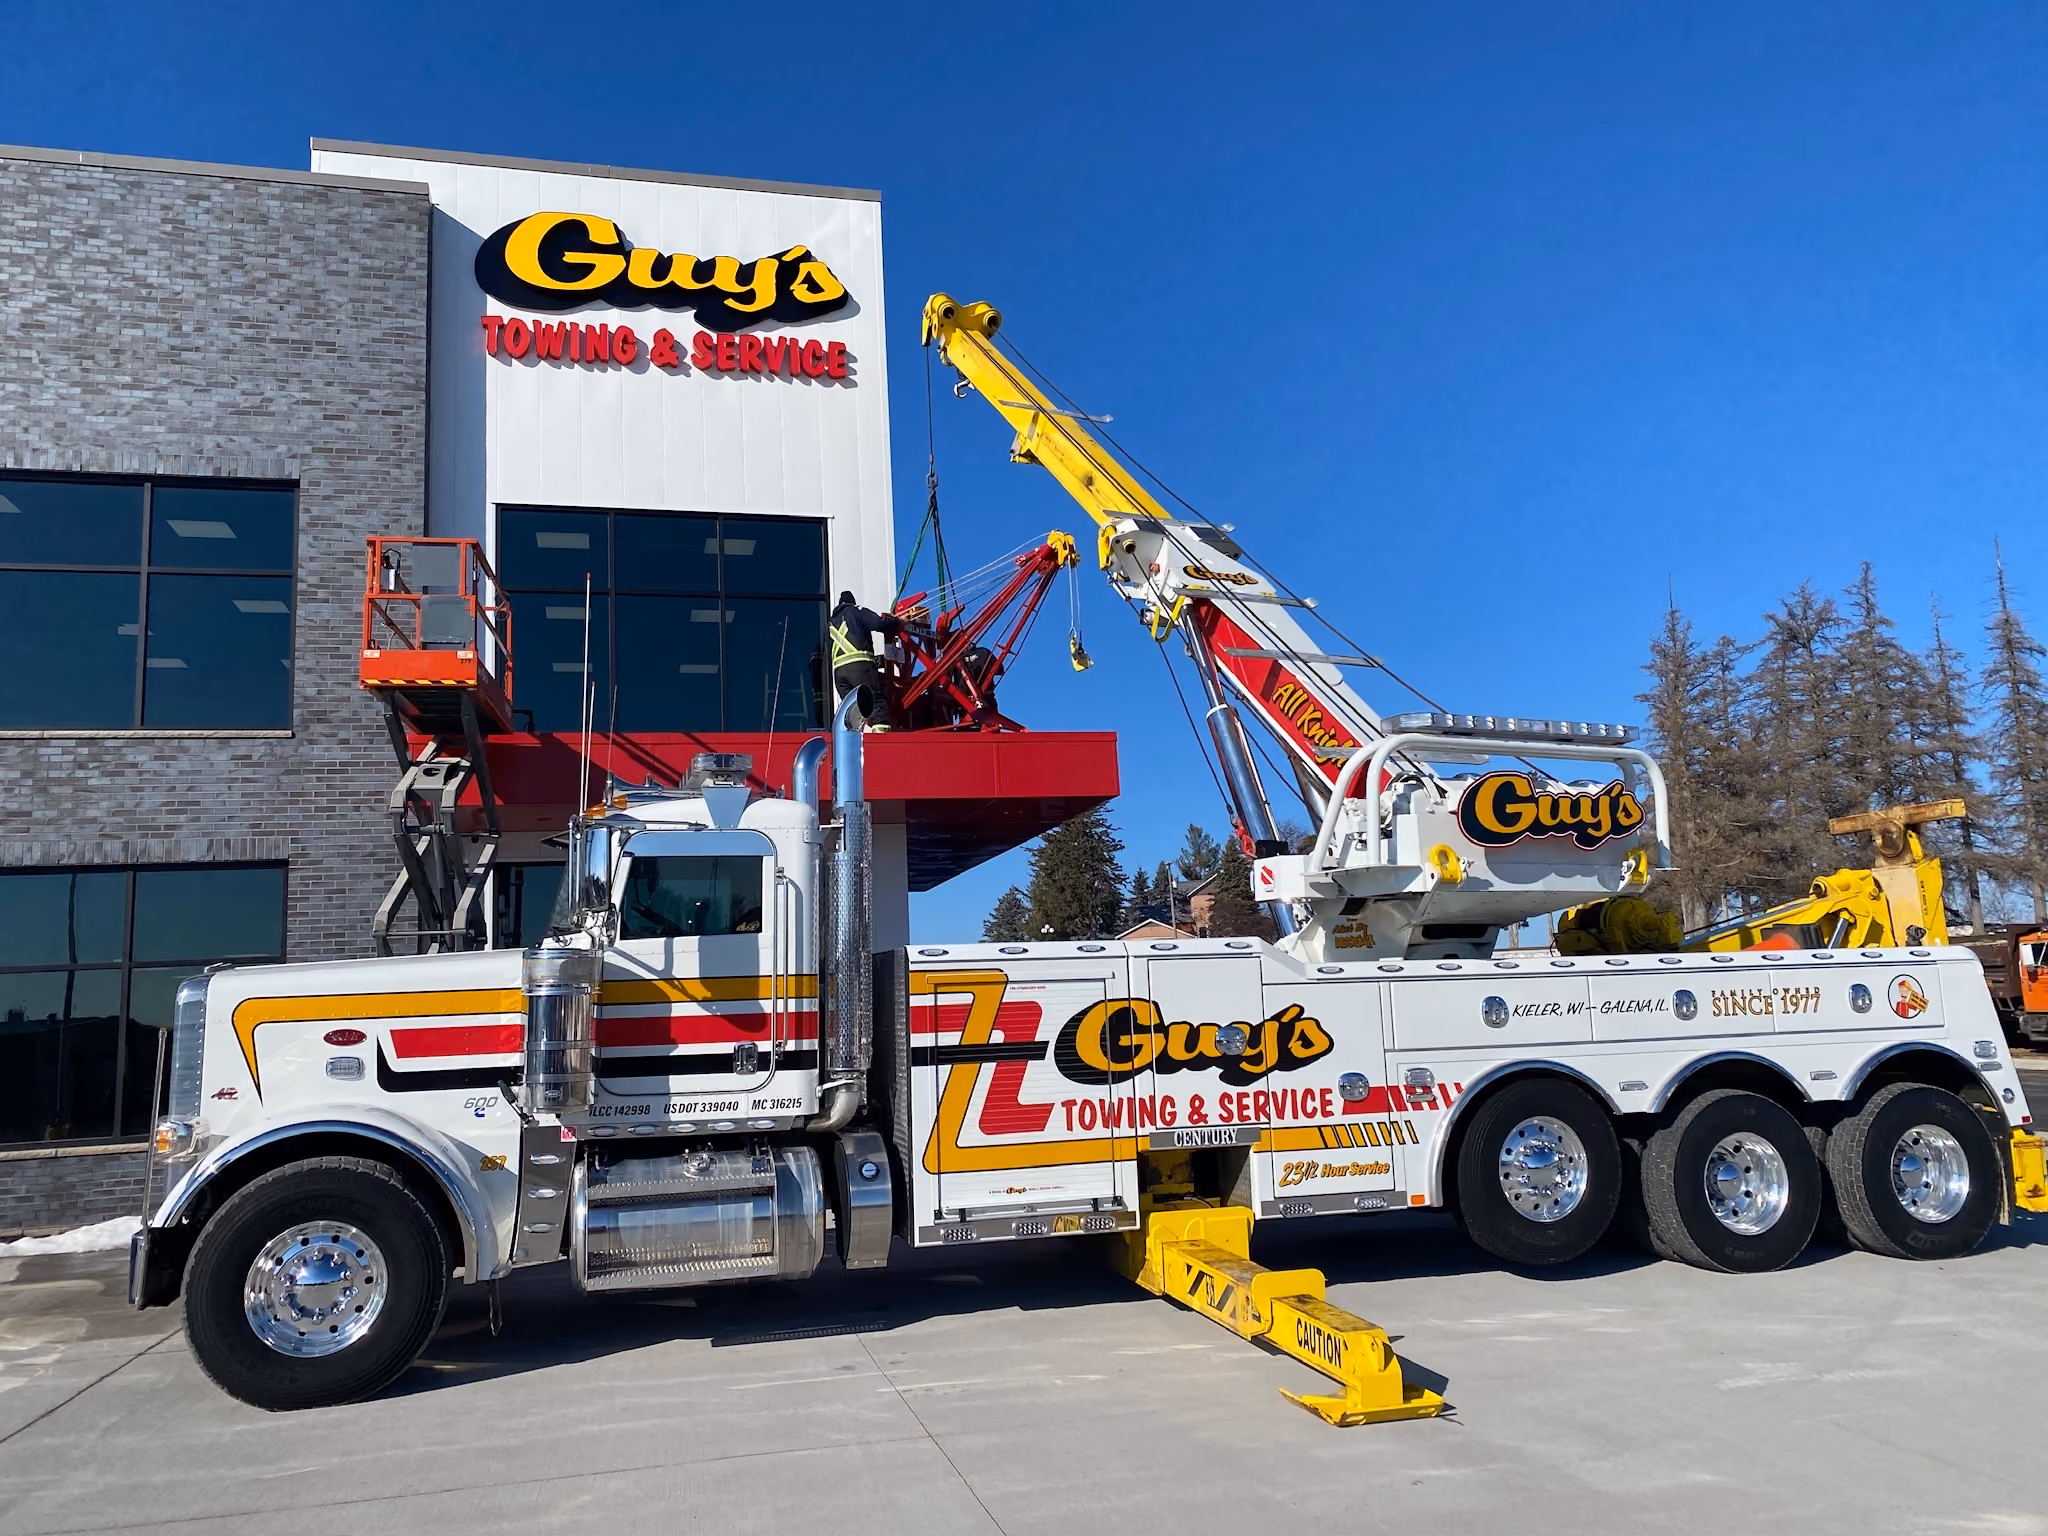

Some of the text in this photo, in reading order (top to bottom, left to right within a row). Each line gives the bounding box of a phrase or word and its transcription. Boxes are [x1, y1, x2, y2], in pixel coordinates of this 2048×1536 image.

[505, 211, 845, 312] Guy's
[481, 315, 849, 380] TOWING & SERVICE
[1272, 682, 1310, 720] All
[1475, 775, 1642, 838] Guy's
[1512, 1002, 1563, 1018] KIELER,
[1567, 1001, 1585, 1015] WI
[1712, 993, 1821, 1017] SINCE 1977
[1075, 999, 1331, 1074] Guy's
[464, 1096, 499, 1109] 600
[613, 1104, 652, 1117] 142998
[699, 1101, 740, 1113] 339040
[751, 1098, 803, 1111] MC 316215
[1061, 1087, 1335, 1132] TOWING & SERVICE
[1173, 1127, 1238, 1148] CENTURY
[1320, 1163, 1349, 1178] Hour
[1349, 1160, 1391, 1177] Service
[1296, 1317, 1342, 1369] CAUTION
